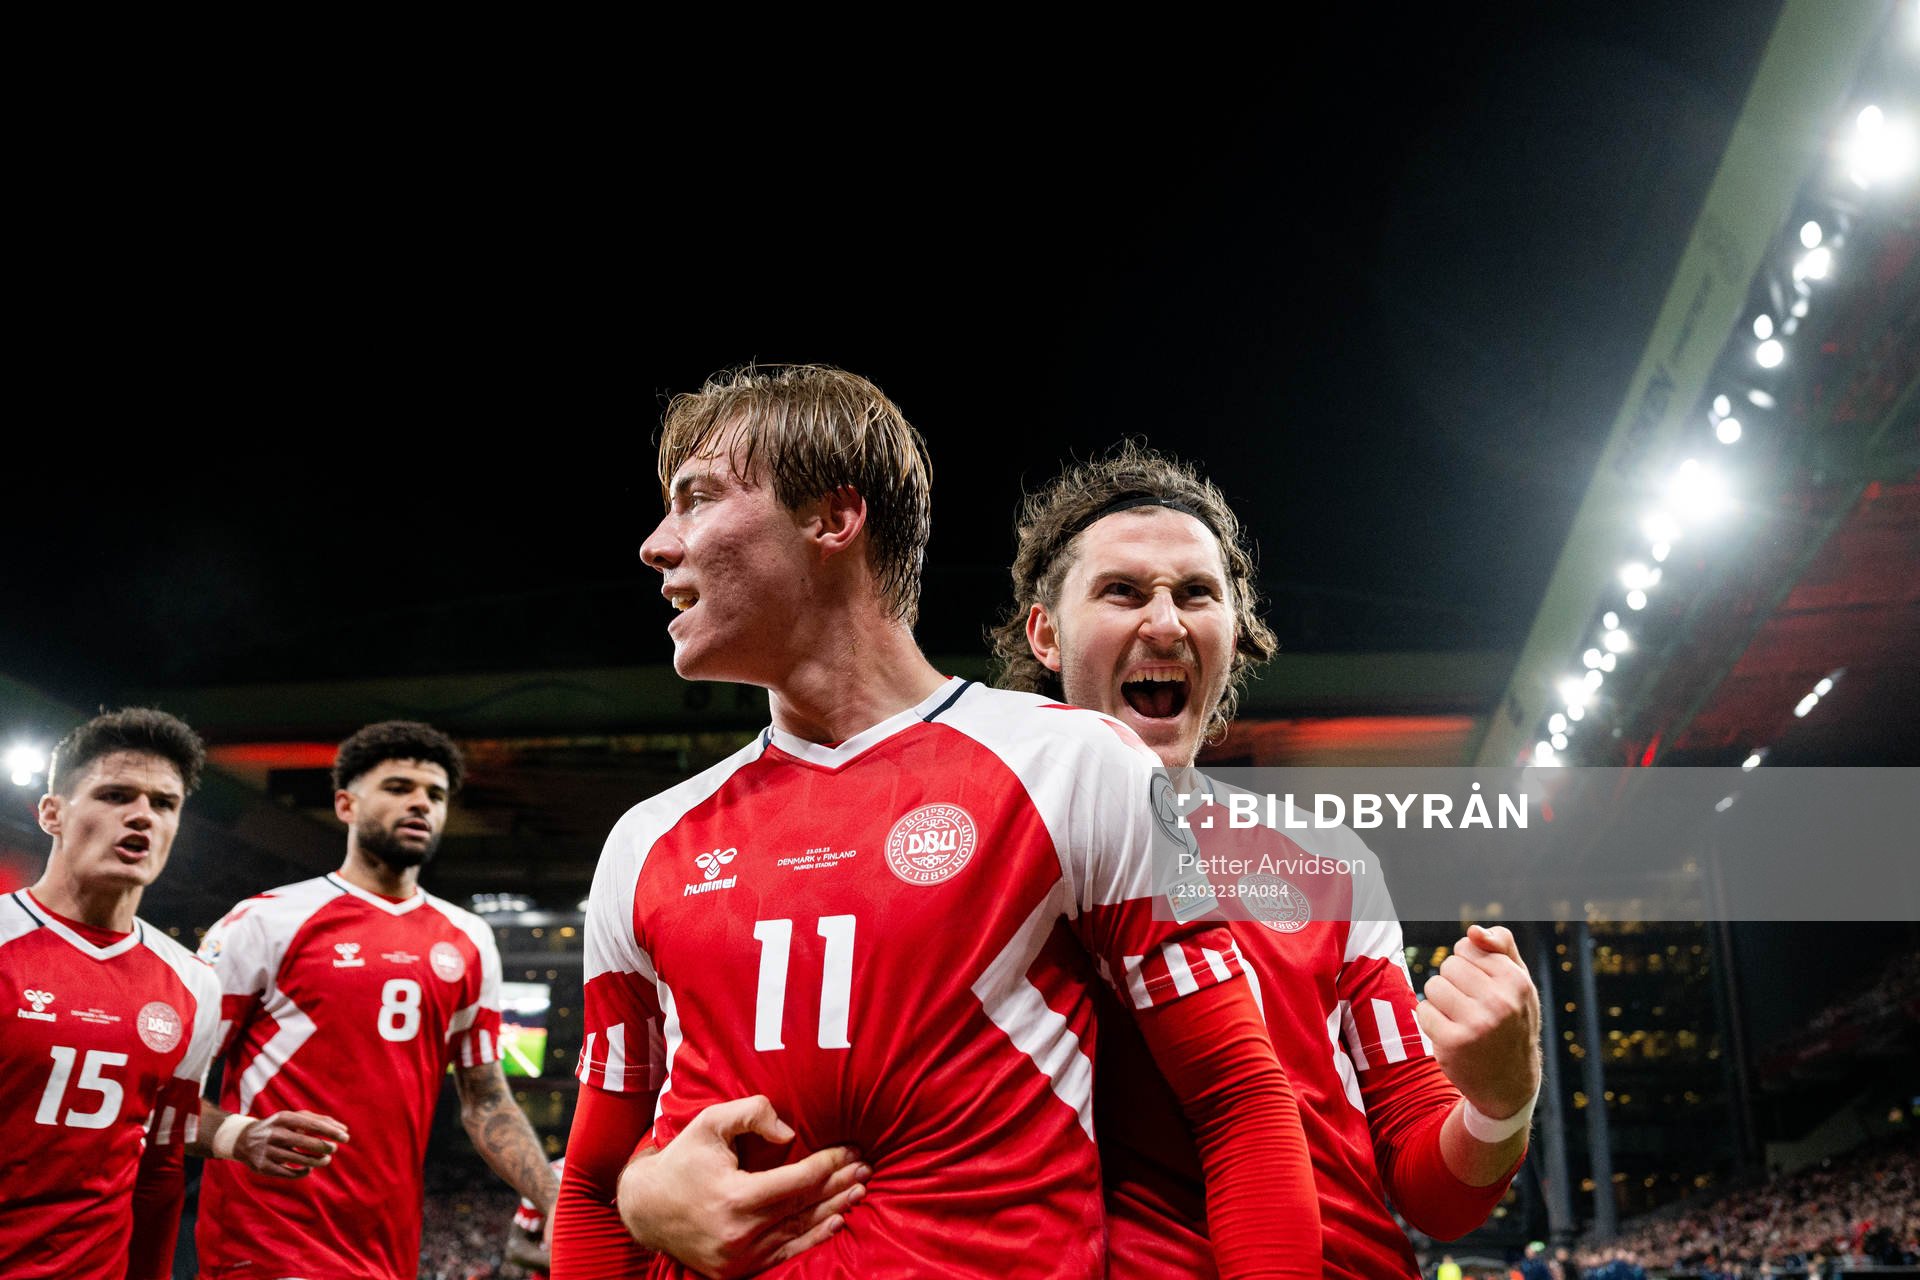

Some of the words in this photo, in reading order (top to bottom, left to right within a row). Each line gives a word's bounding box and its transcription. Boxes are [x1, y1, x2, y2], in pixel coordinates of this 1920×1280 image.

[906, 830, 957, 855] DBU
[777, 855, 816, 866] DENMARK
[823, 850, 857, 860] FINLAND
[684, 874, 738, 897] hummel
[914, 869, 948, 880] 1889
[753, 914, 857, 1052] 11
[377, 978, 422, 1042] 8
[35, 1045, 129, 1130] 15
